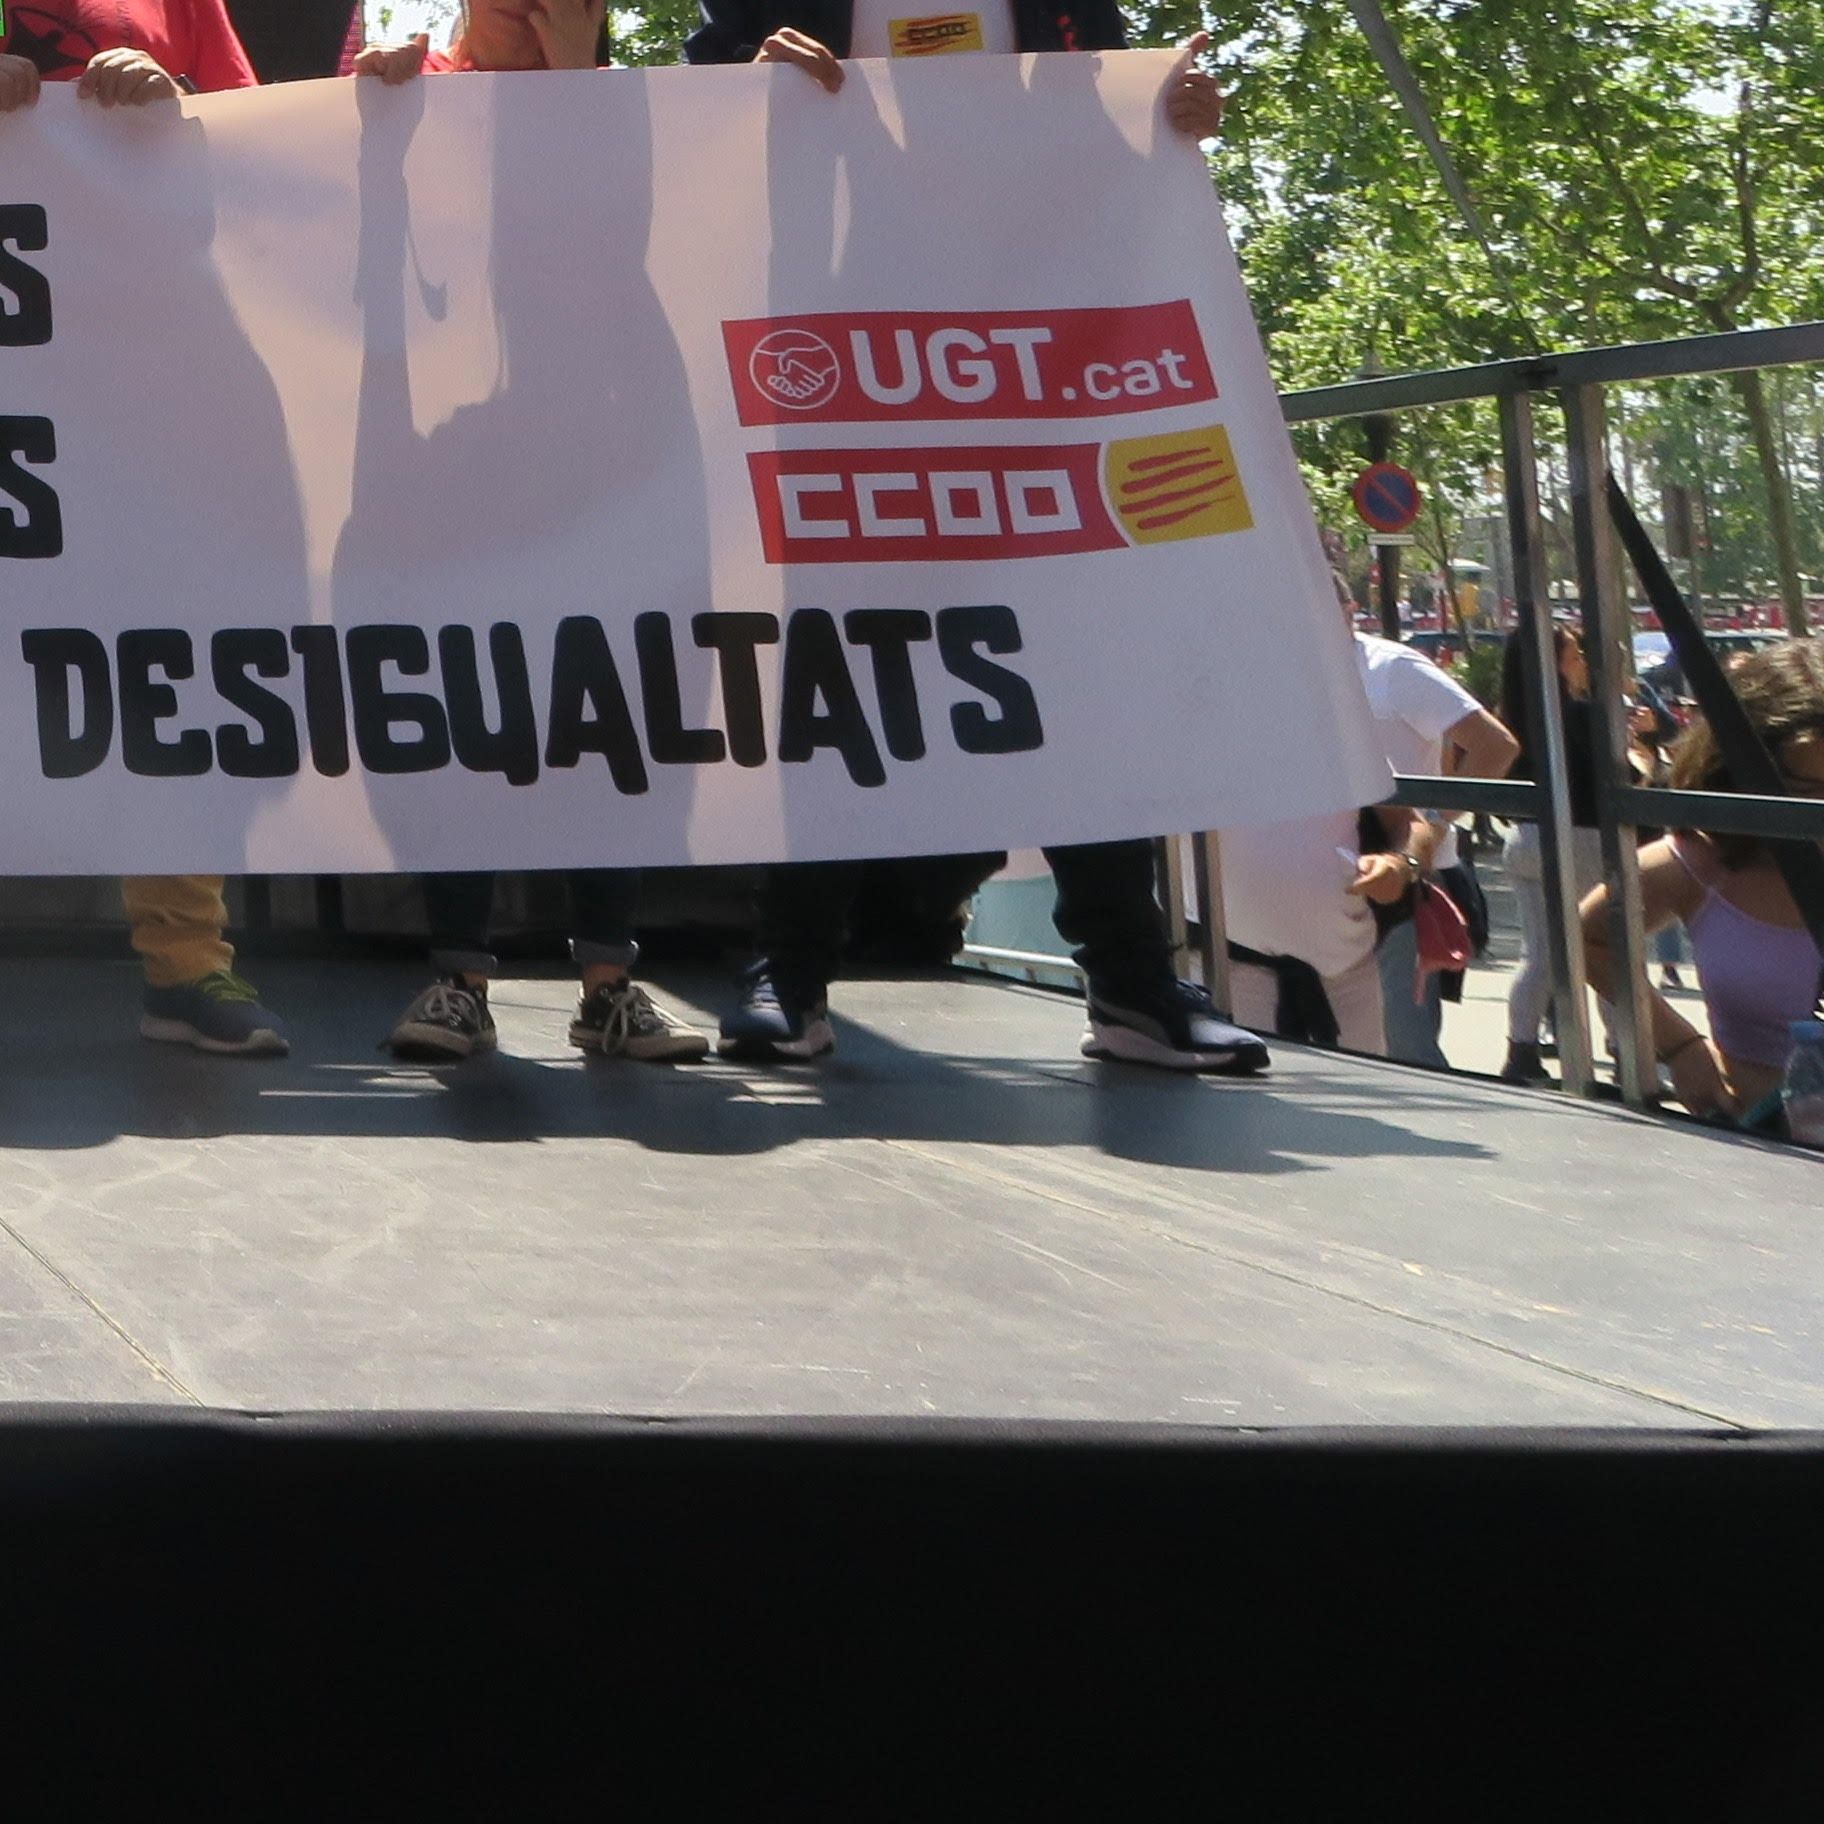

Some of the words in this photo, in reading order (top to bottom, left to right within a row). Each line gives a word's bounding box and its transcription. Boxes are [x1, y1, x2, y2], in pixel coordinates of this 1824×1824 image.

[848, 326, 1194, 406] UGT.cat
[776, 467, 1084, 540] CCOO
[20, 605, 1046, 796] DESIGUALTATS
